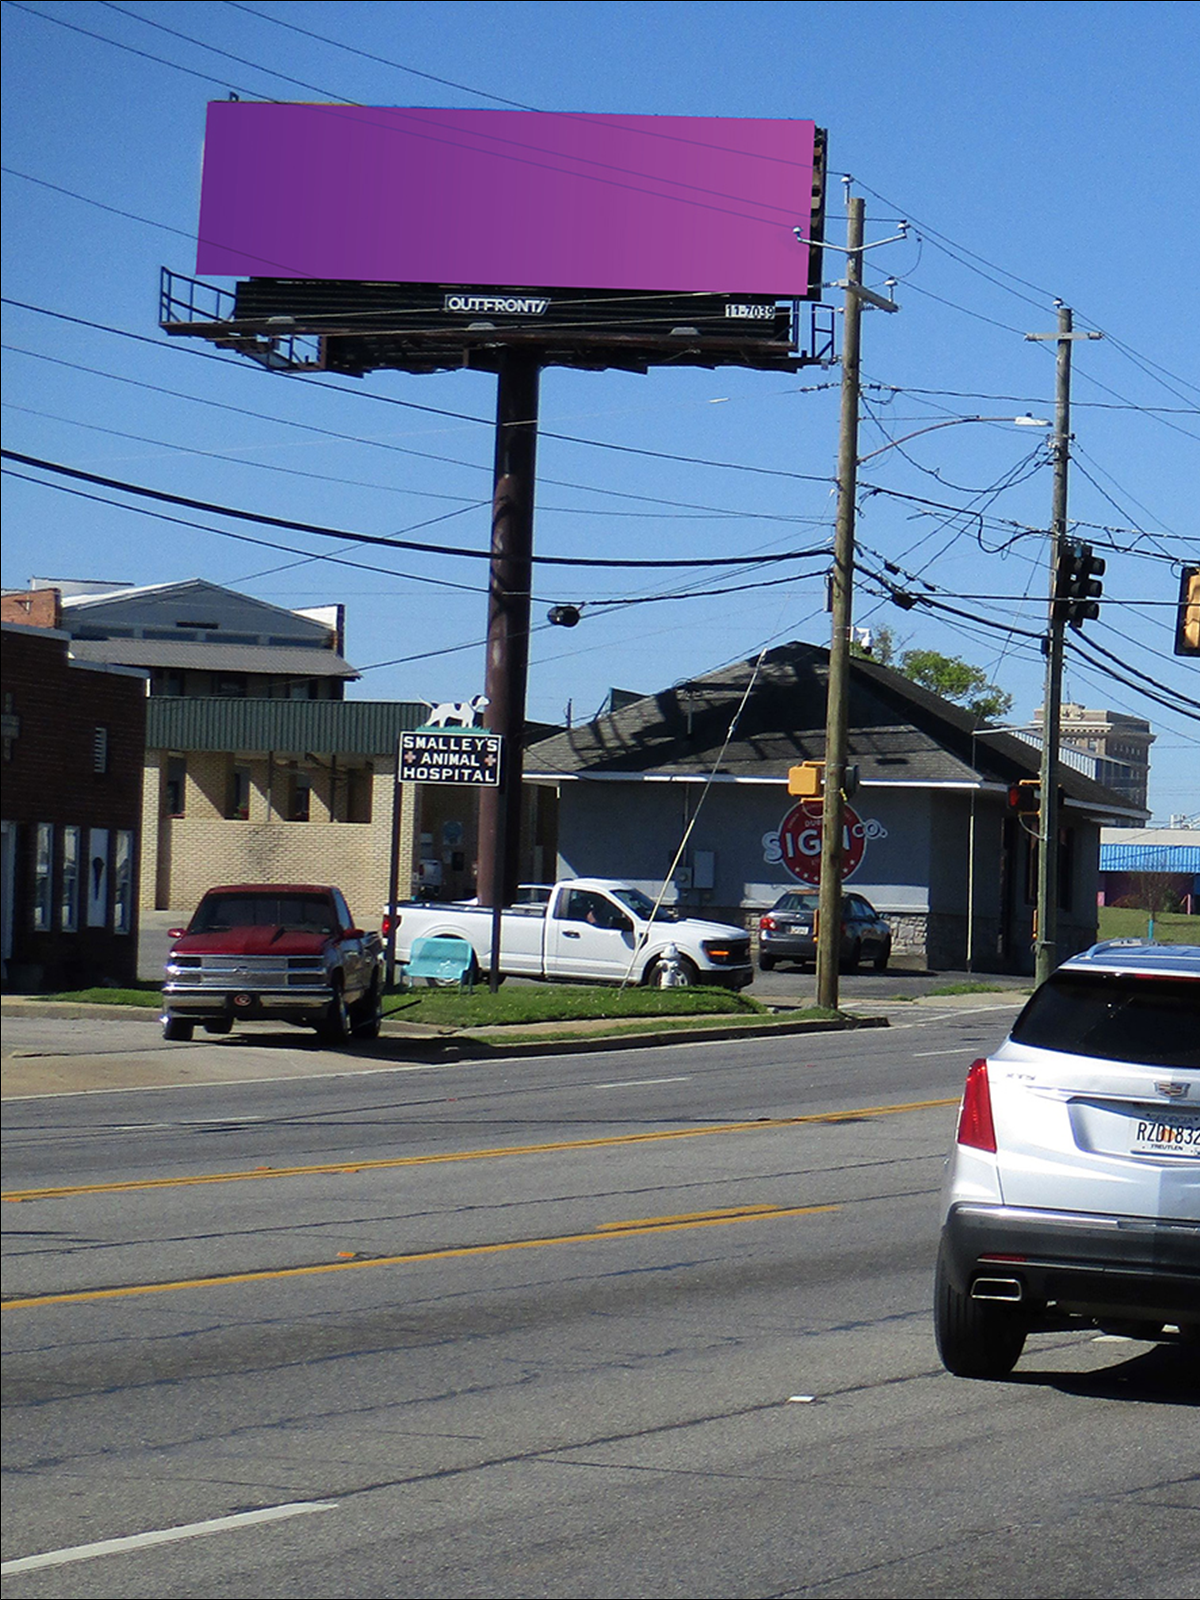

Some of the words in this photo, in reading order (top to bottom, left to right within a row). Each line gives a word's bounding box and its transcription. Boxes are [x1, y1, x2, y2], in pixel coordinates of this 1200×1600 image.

[727, 305, 775, 319] 11-7039
[403, 736, 498, 752] SMALLEY'S
[420, 752, 480, 767] ANIMAL
[403, 767, 495, 782] HOSPITAL
[762, 826, 851, 863] SIG
